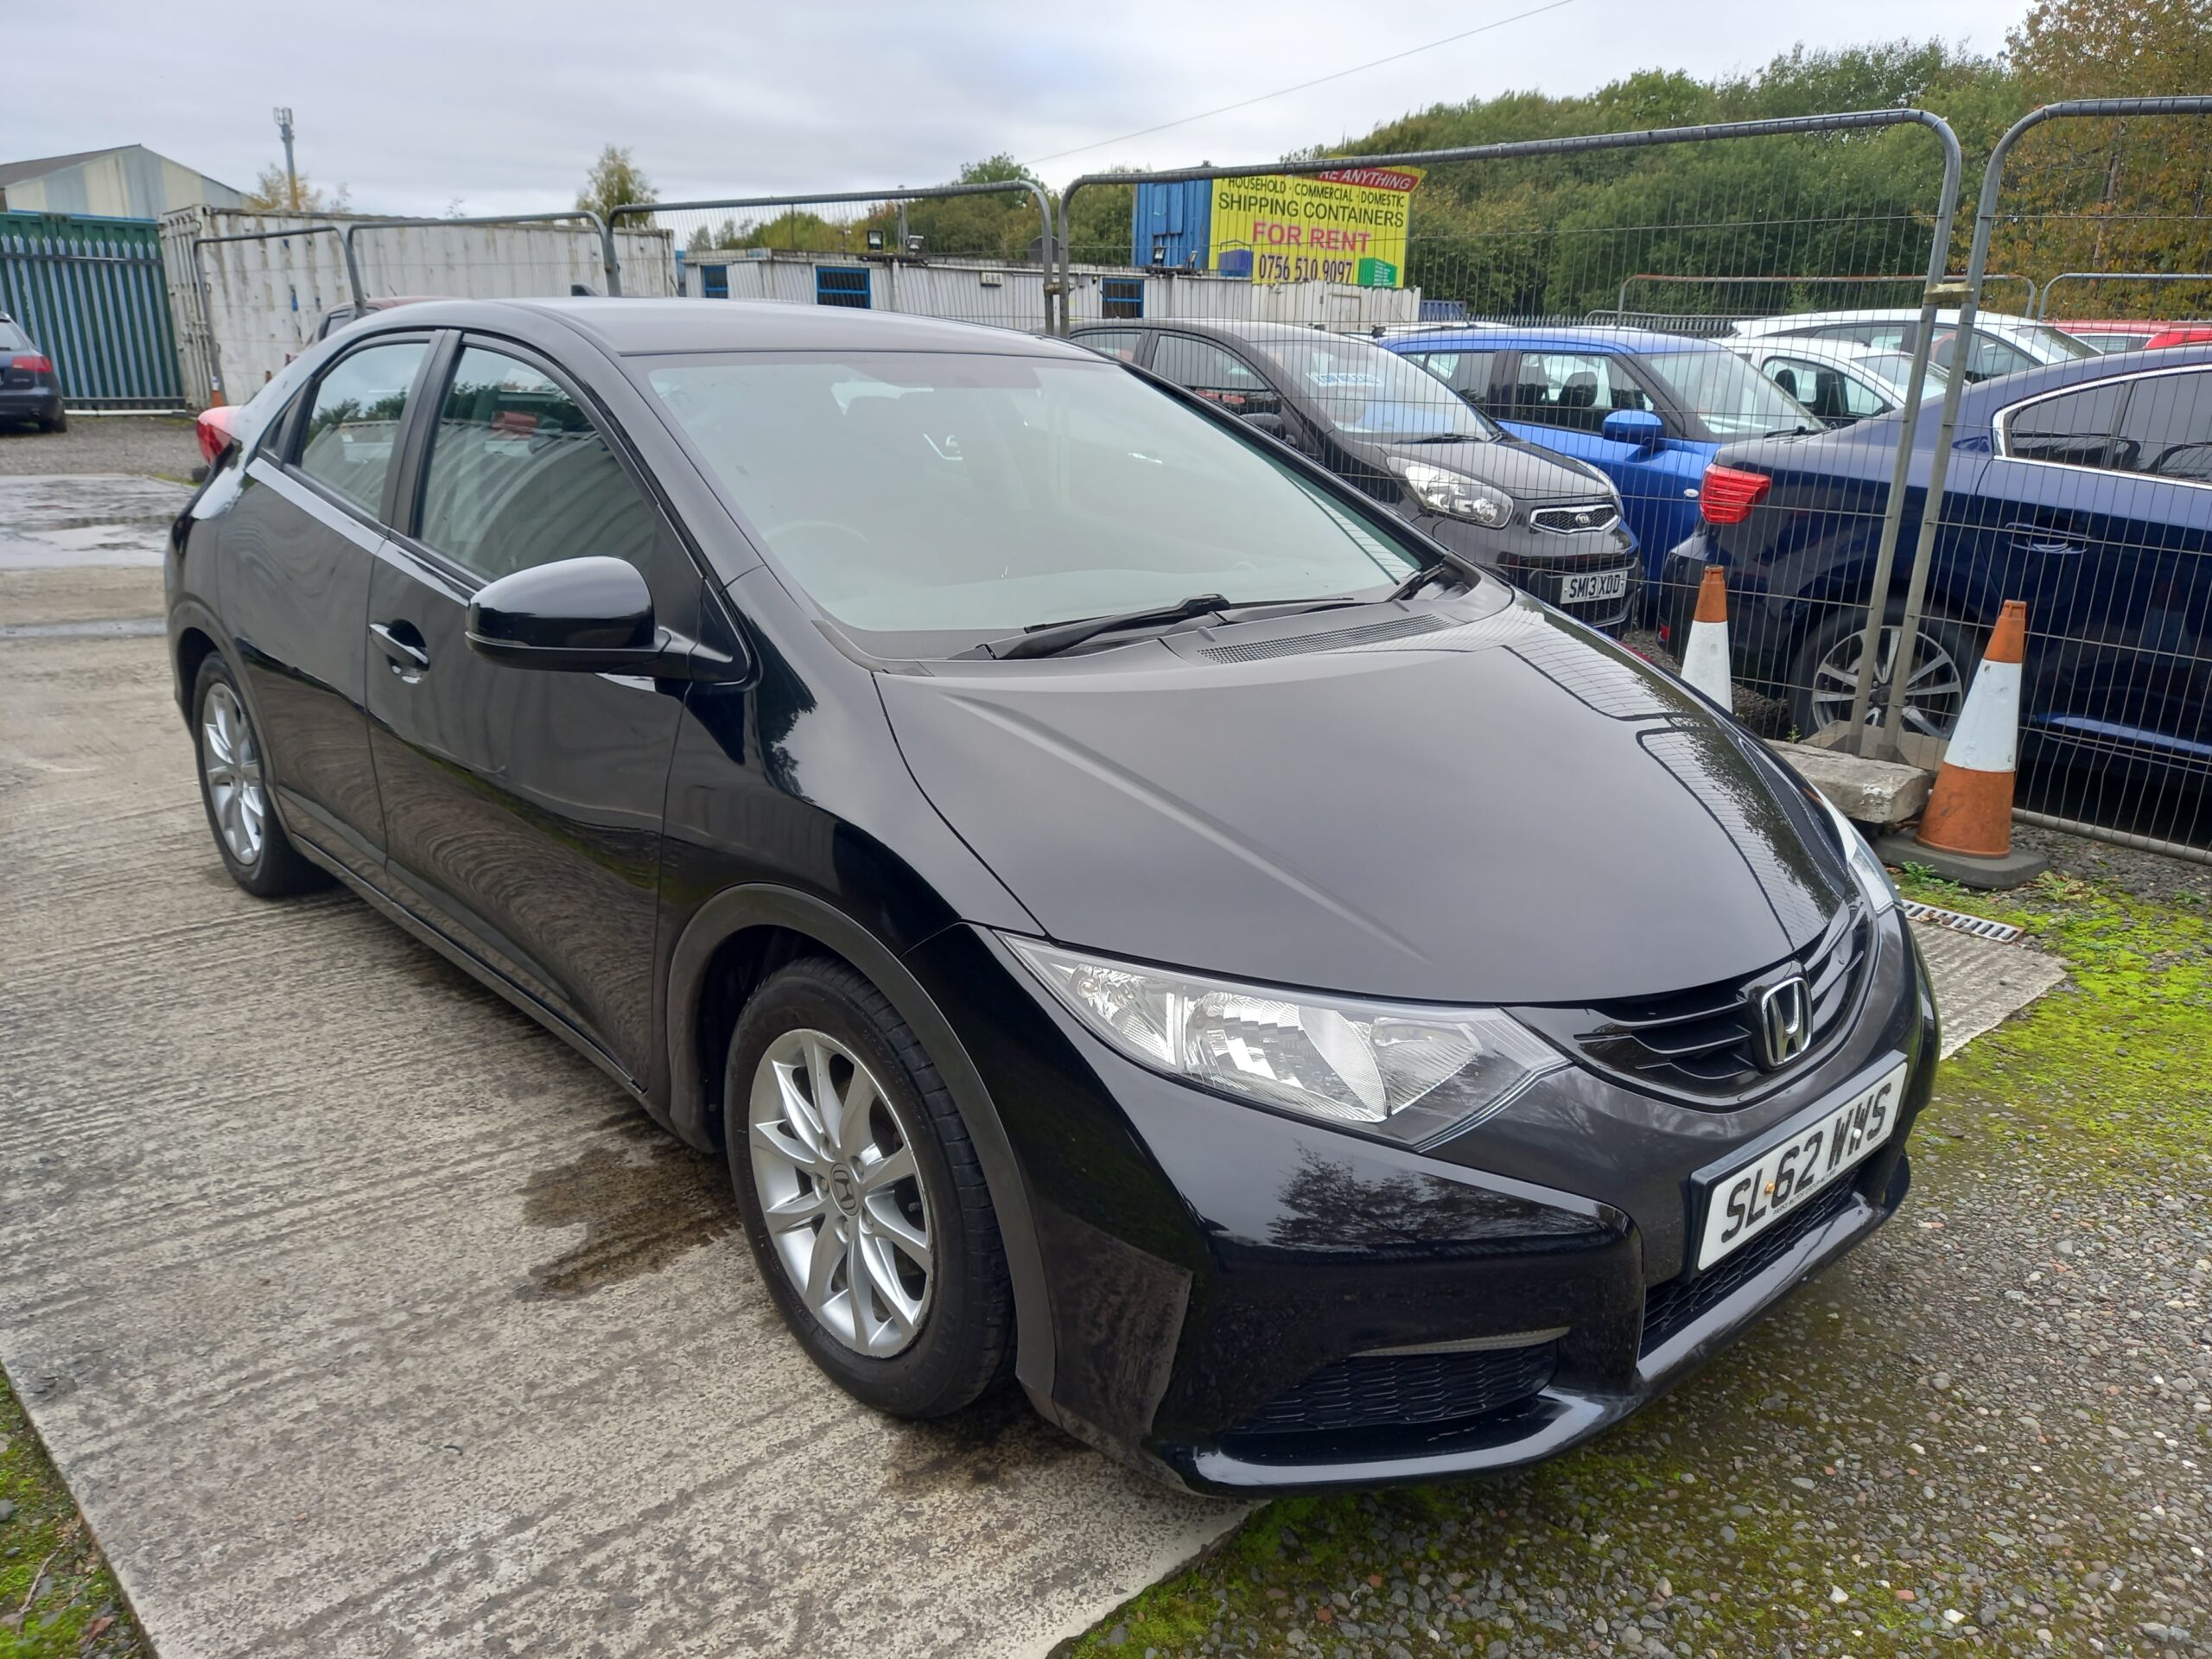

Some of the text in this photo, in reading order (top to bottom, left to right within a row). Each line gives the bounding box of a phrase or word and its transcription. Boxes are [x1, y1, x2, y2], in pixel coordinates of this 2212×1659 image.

[1228, 177, 1405, 207] HOUSEHOLD COMMERCIAL DOMESTIC
[1340, 168, 1411, 189] ANYTHING
[1218, 192, 1404, 227] SHIPPING CONTAINERS
[1253, 221, 1370, 253] FOR RENT
[1259, 254, 1290, 281] 0756
[1323, 259, 1352, 284] 9097
[1569, 576, 1597, 598] SM13
[1721, 1082, 1892, 1244] SL62 WWS
